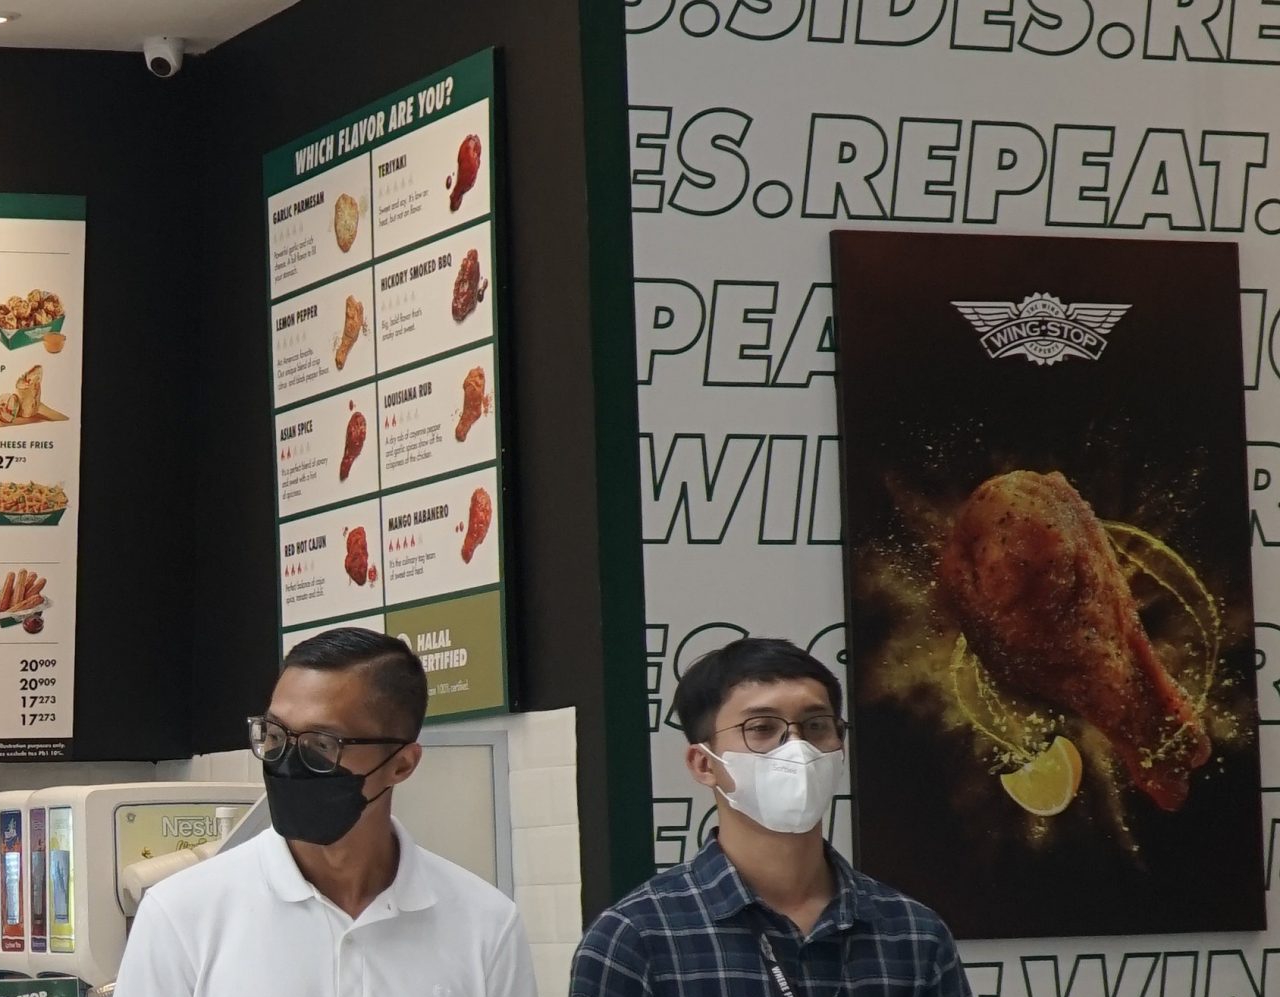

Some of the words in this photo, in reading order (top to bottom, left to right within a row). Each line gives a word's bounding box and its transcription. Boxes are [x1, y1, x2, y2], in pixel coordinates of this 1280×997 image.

[295, 137, 335, 176] WHICH
[338, 111, 384, 155] FLAVOR
[388, 96, 414, 132] ARE
[418, 77, 454, 118] YOU?
[378, 154, 407, 178] TERIYAKI
[273, 205, 293, 225] GARLIC
[294, 191, 325, 217] PARMESAN
[380, 270, 408, 291] HICKORY
[410, 261, 437, 282] SMOKED
[438, 253, 452, 269] BBQ
[276, 312, 294, 331] LEMON
[295, 305, 318, 325] PEPPER
[384, 386, 418, 408] LOUISIANA
[420, 382, 433, 398] RUB
[280, 425, 296, 441] ASIAN
[297, 420, 313, 436] SPICE
[30, 440, 54, 449] FRIES
[388, 513, 412, 531] MANGO
[413, 504, 449, 526] HABANERO
[285, 544, 295, 557] RED
[296, 540, 308, 554] HOT
[308, 536, 327, 551] CAJUN
[417, 629, 452, 651] HALAL
[771, 966, 790, 992] WHERE
